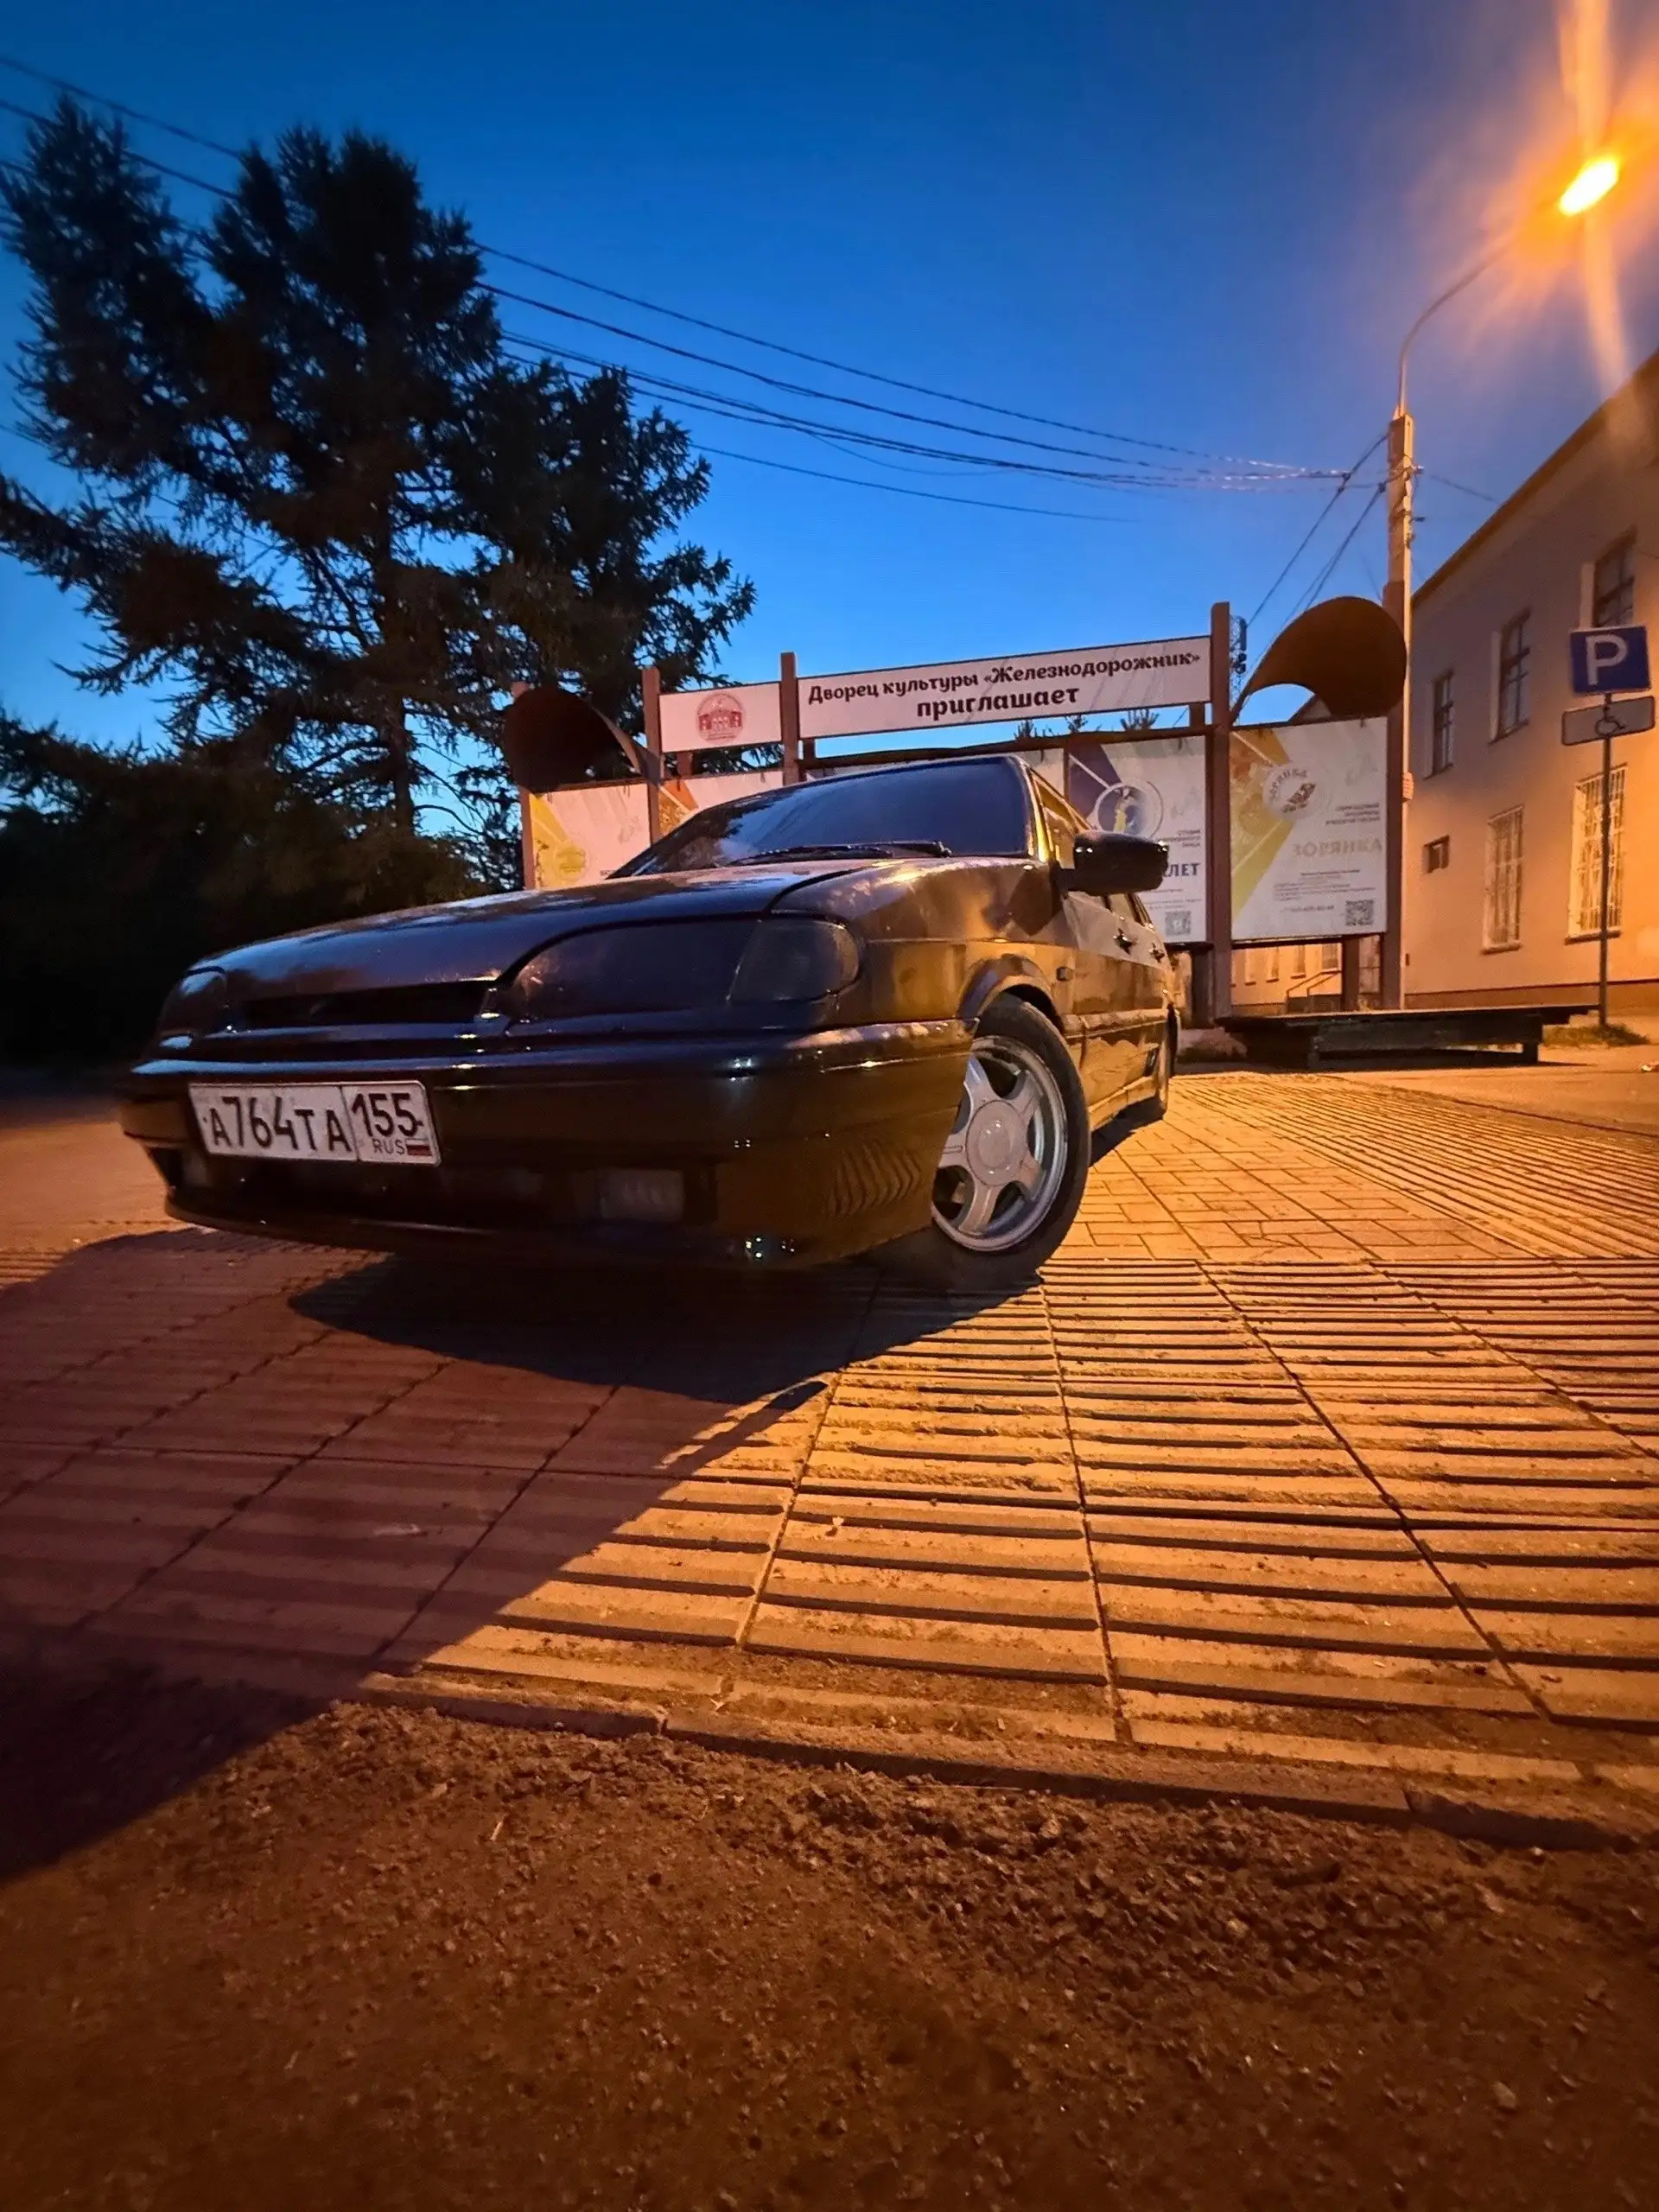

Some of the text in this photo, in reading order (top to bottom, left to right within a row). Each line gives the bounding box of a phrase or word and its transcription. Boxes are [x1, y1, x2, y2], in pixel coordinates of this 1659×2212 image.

[808, 652, 1201, 705] Дворец культуры «Железнодорожник»
[1586, 634, 1627, 685] P
[916, 687, 1080, 721] приглашает
[1163, 862, 1201, 877] ЛЕТ
[208, 1092, 418, 1153] А764ТА 155
[372, 1138, 406, 1154] RUS
